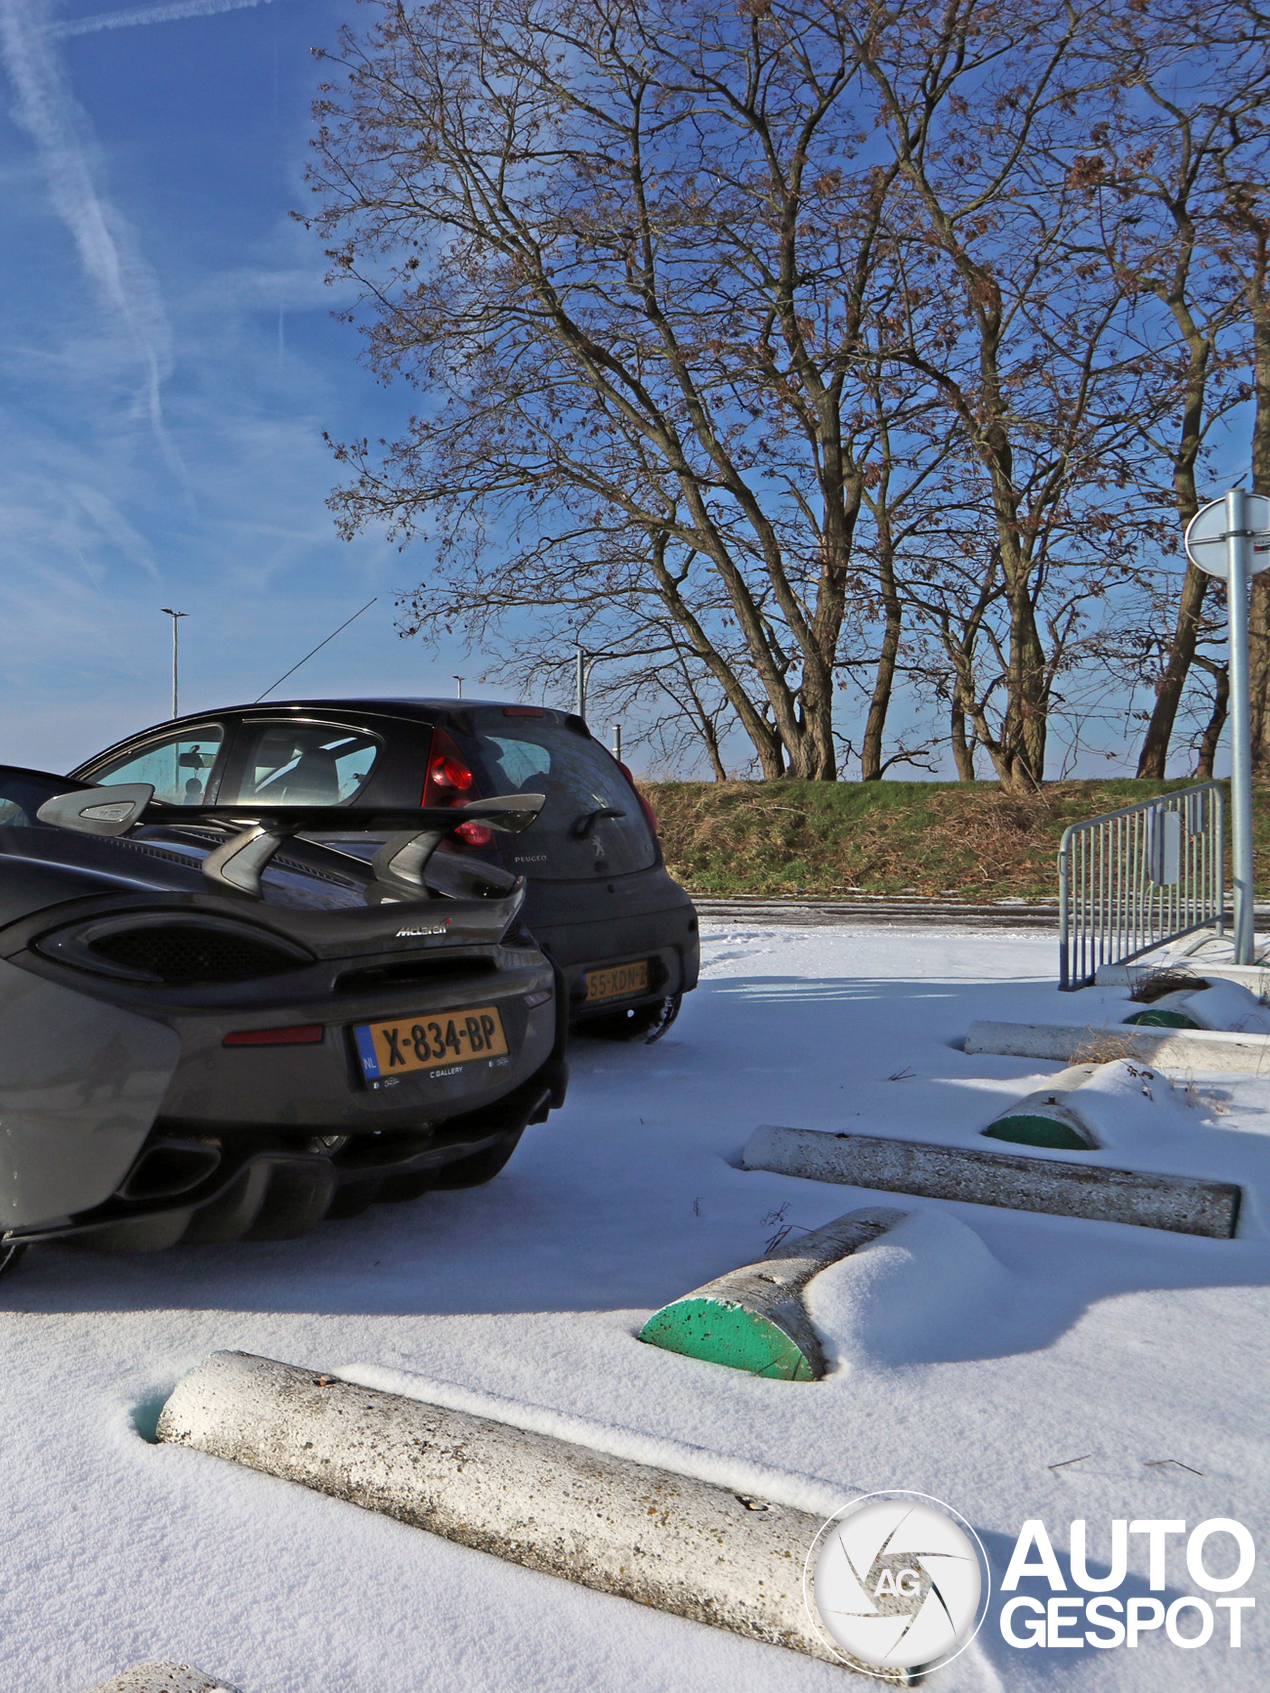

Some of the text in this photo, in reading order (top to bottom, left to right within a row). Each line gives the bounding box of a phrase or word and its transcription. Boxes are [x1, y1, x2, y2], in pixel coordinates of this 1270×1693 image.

[382, 1014, 496, 1067] X-834-BP
[363, 1057, 377, 1070] NL
[436, 1066, 463, 1078] GALLERY
